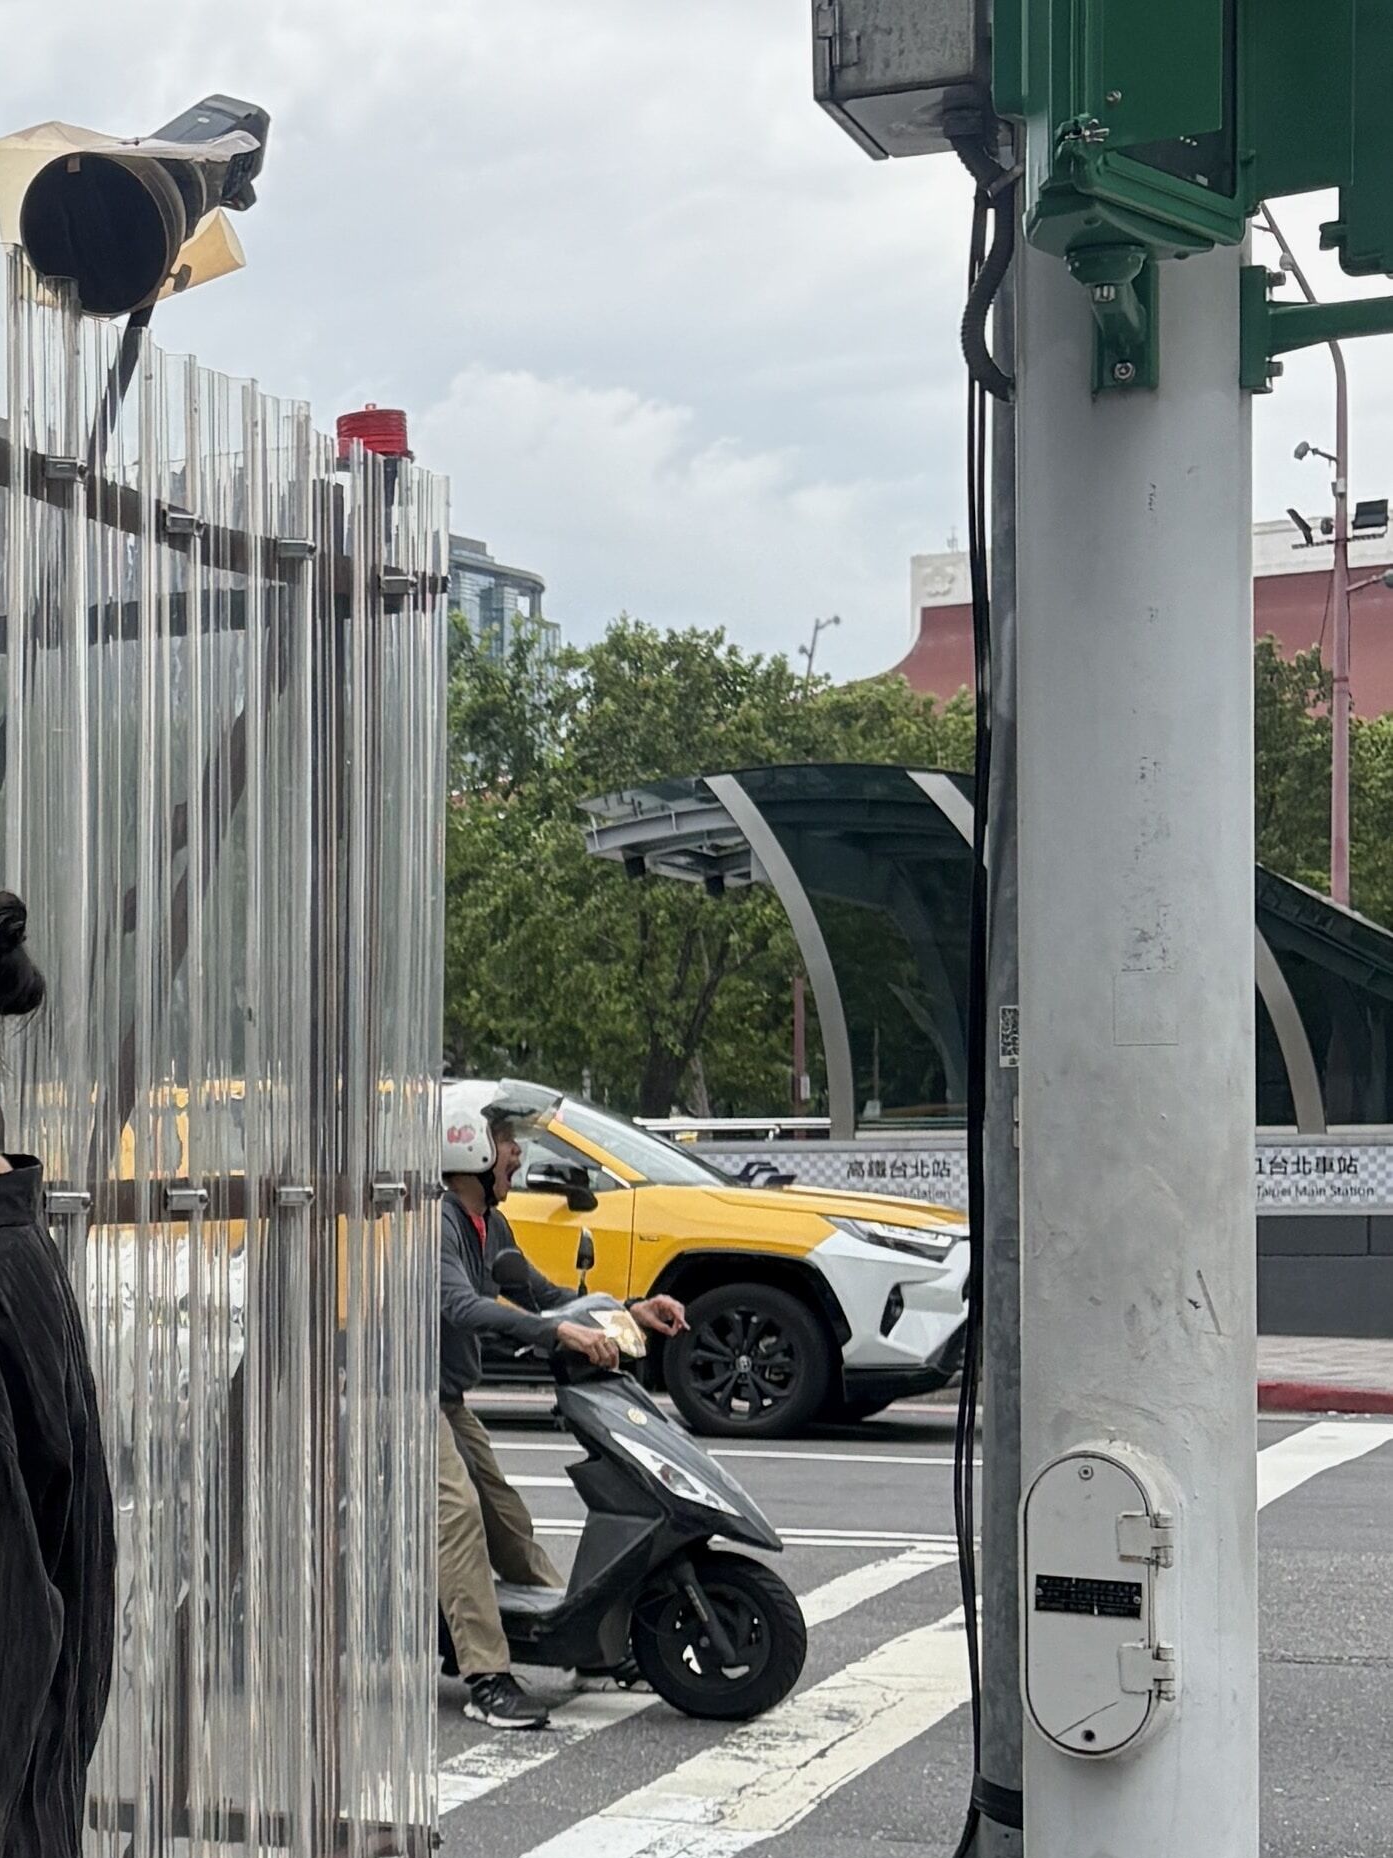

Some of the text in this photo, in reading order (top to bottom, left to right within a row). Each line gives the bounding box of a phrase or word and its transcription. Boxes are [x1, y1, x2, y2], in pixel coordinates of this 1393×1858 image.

[847, 1159, 951, 1179] 高鐵台北站
[1295, 1185, 1326, 1197] Main
[1331, 1185, 1374, 1197] Station
